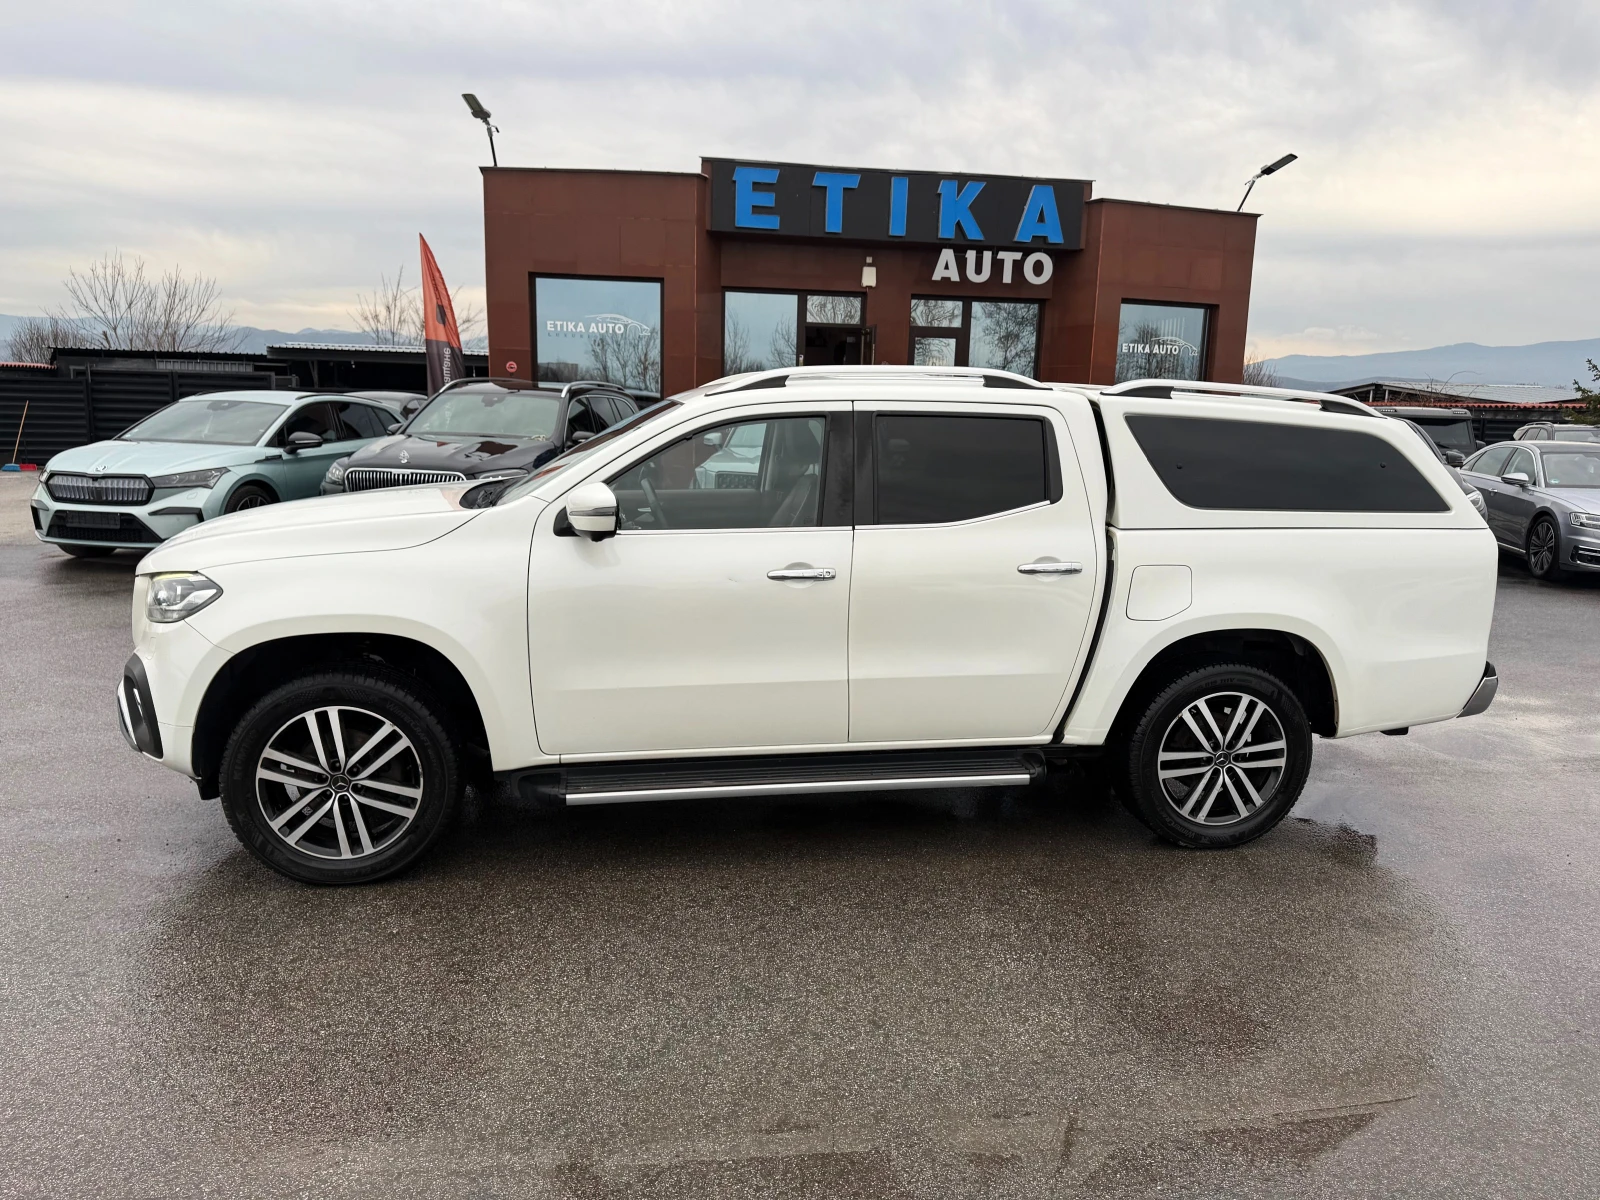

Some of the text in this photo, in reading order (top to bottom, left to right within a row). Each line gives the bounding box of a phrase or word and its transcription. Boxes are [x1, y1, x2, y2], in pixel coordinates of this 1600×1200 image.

[732, 166, 1064, 245] ETIKA
[931, 248, 1054, 286] AUTO
[546, 320, 625, 334] ETIKA AUTO
[1122, 342, 1180, 355] ETIKA AUTO
